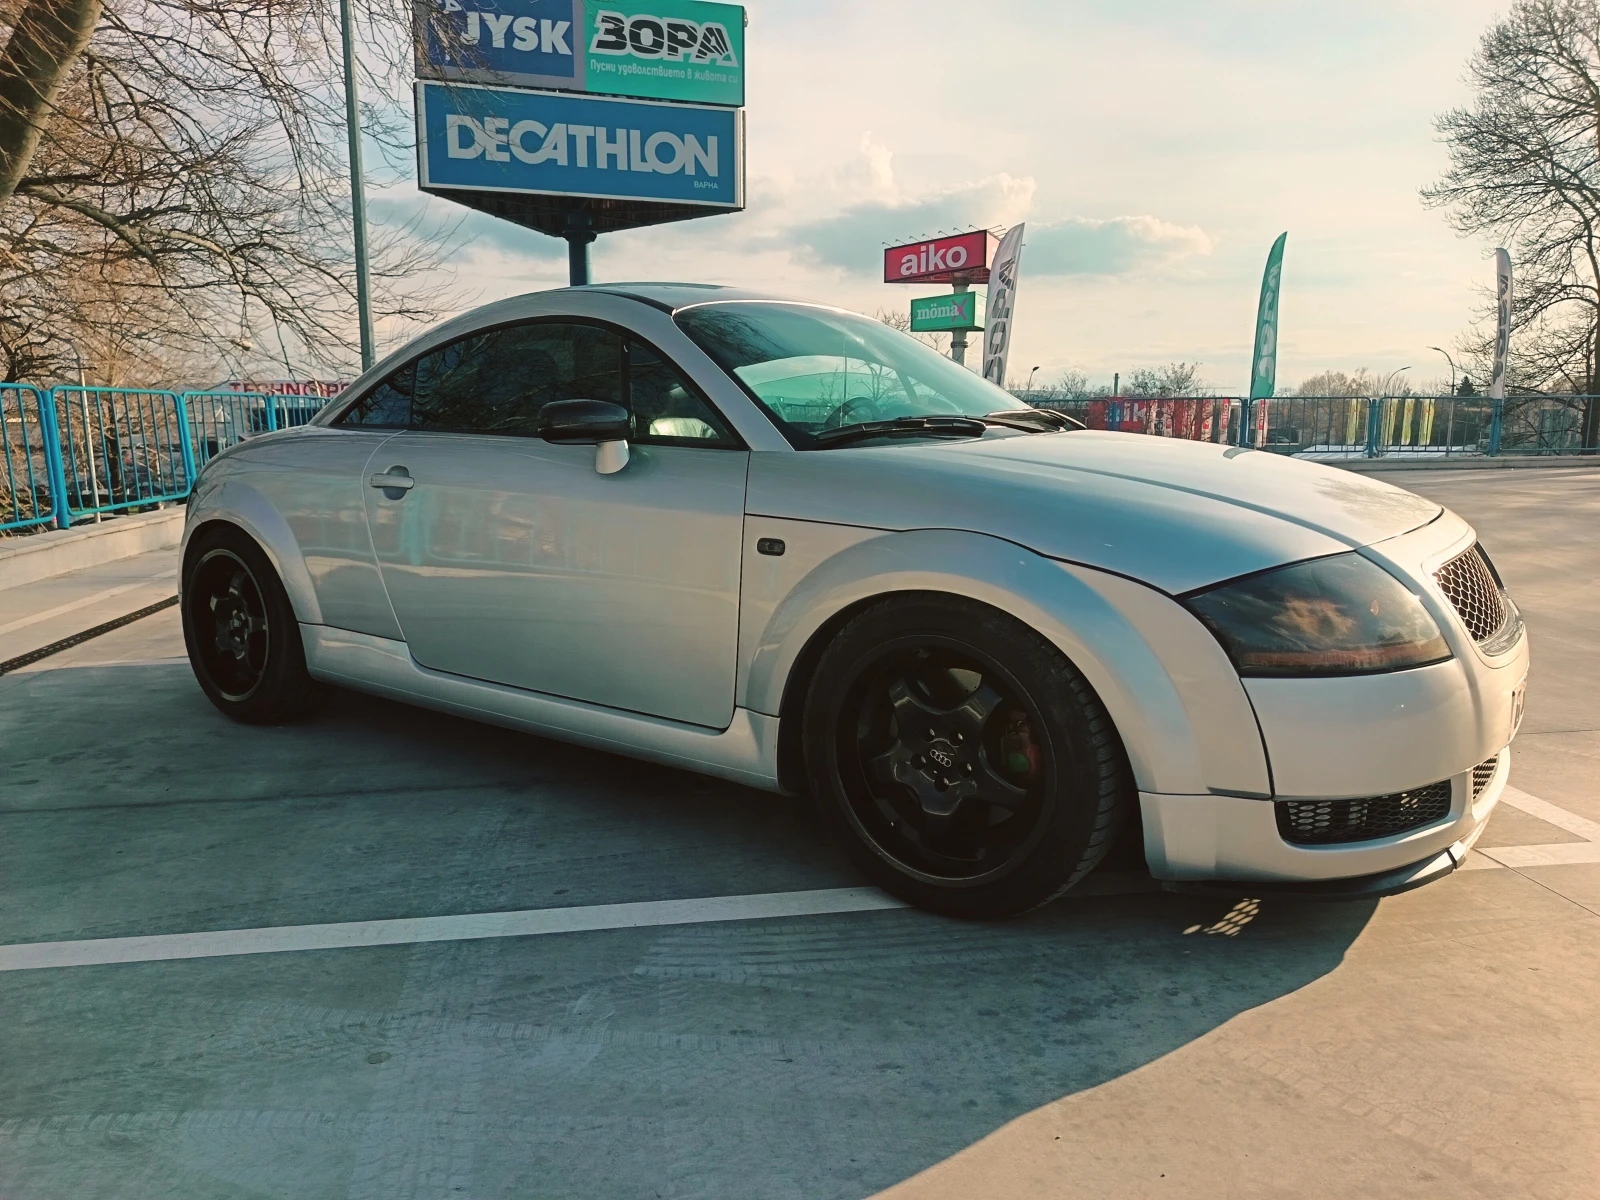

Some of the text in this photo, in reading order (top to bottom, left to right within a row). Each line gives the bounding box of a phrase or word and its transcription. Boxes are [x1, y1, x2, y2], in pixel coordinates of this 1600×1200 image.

[460, 11, 572, 55] JYSK
[589, 10, 738, 67] ЗОРА
[590, 59, 738, 84] Пусни удоволствието в живота си
[445, 113, 719, 177] DECATHLON
[693, 179, 719, 189] ВАРНА
[900, 243, 968, 276] aiko
